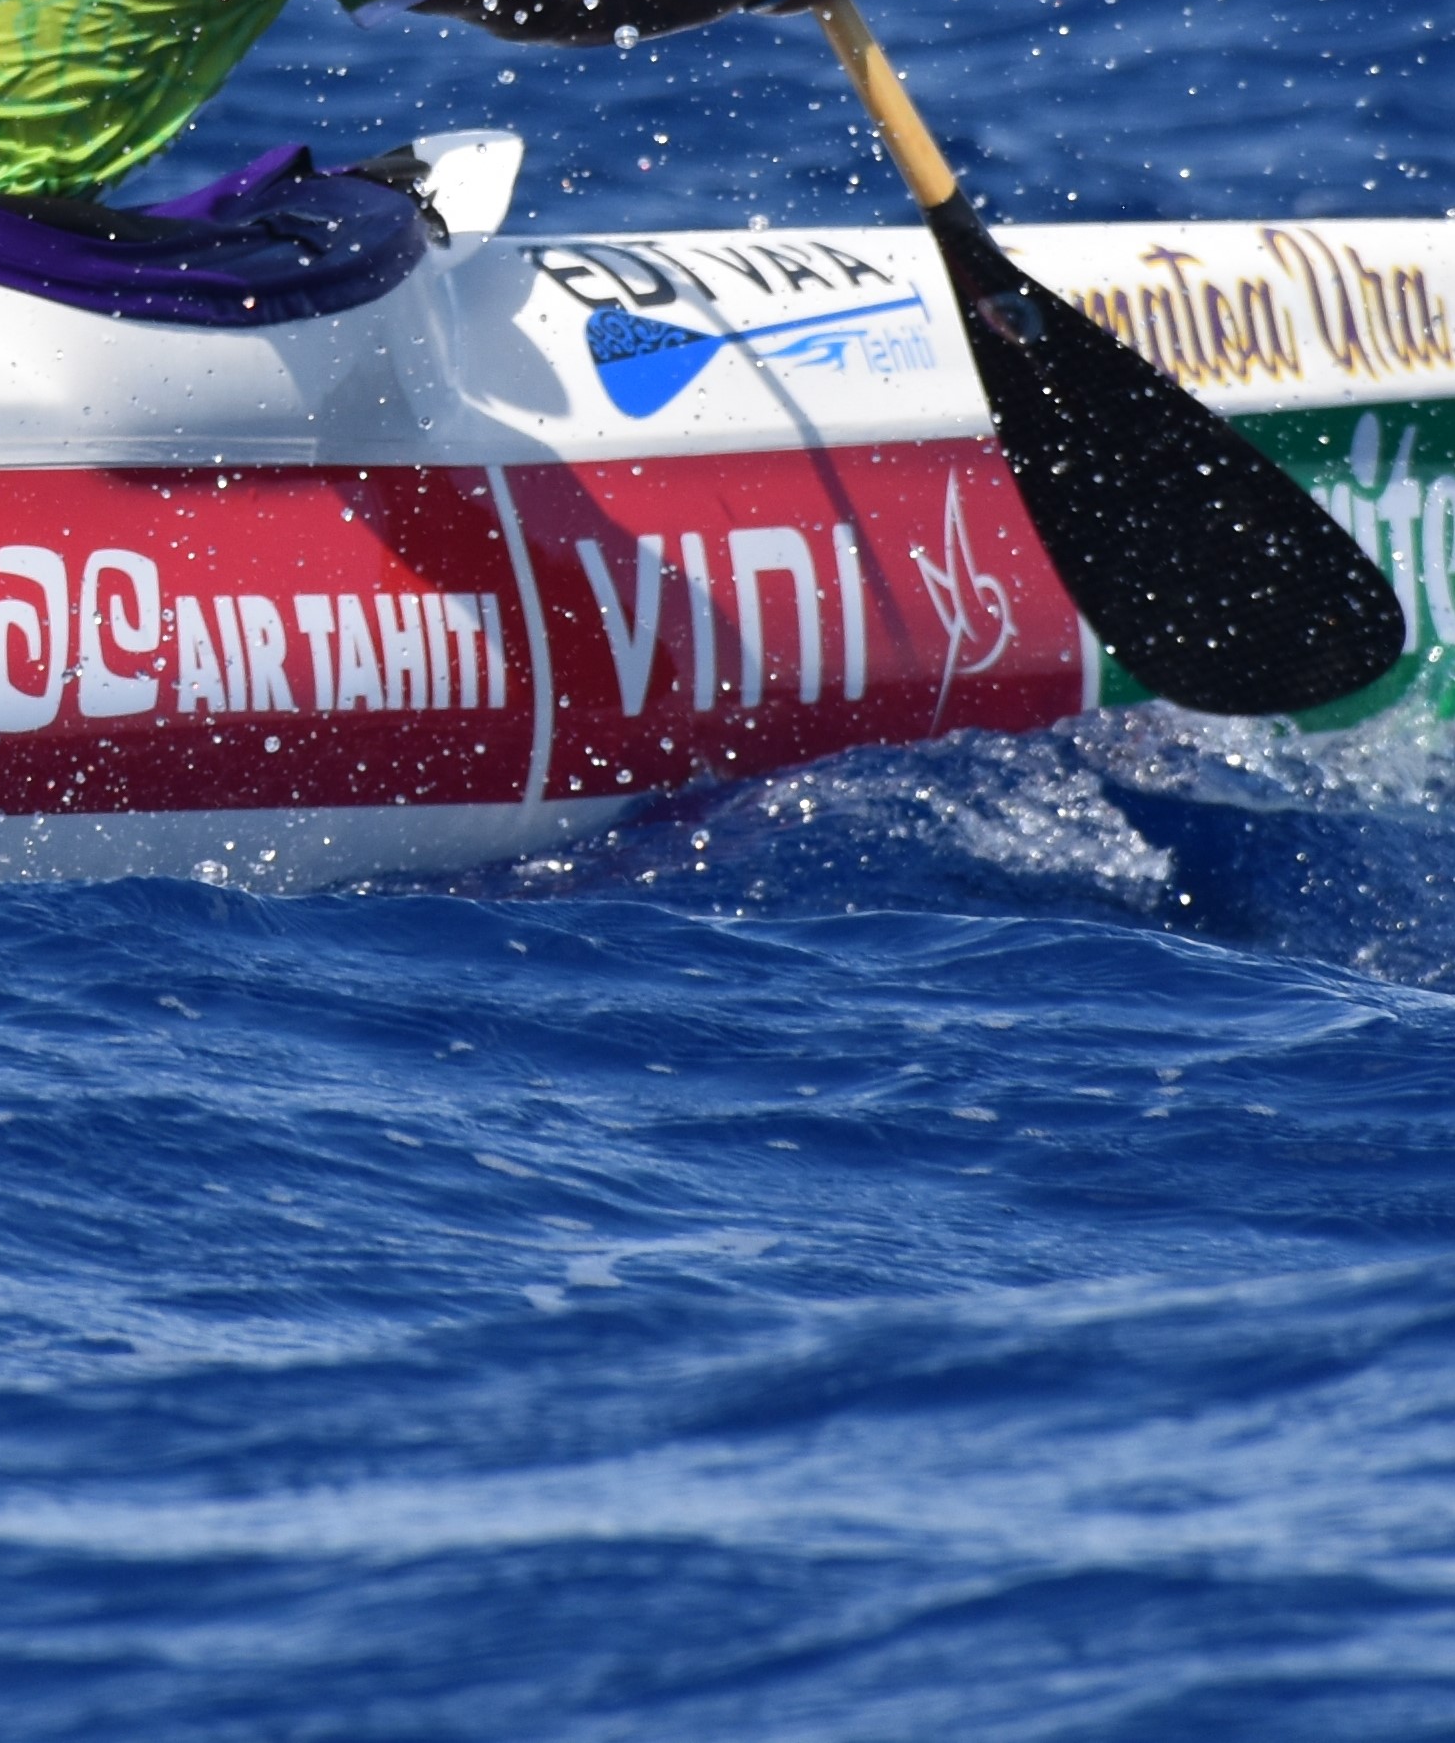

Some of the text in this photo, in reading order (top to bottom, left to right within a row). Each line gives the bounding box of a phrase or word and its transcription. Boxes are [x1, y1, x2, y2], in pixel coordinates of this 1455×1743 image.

[518, 241, 717, 312] EDT
[865, 322, 938, 376] Tahiti
[175, 592, 507, 715] AIR TAHITI
[575, 523, 867, 718] VINI
